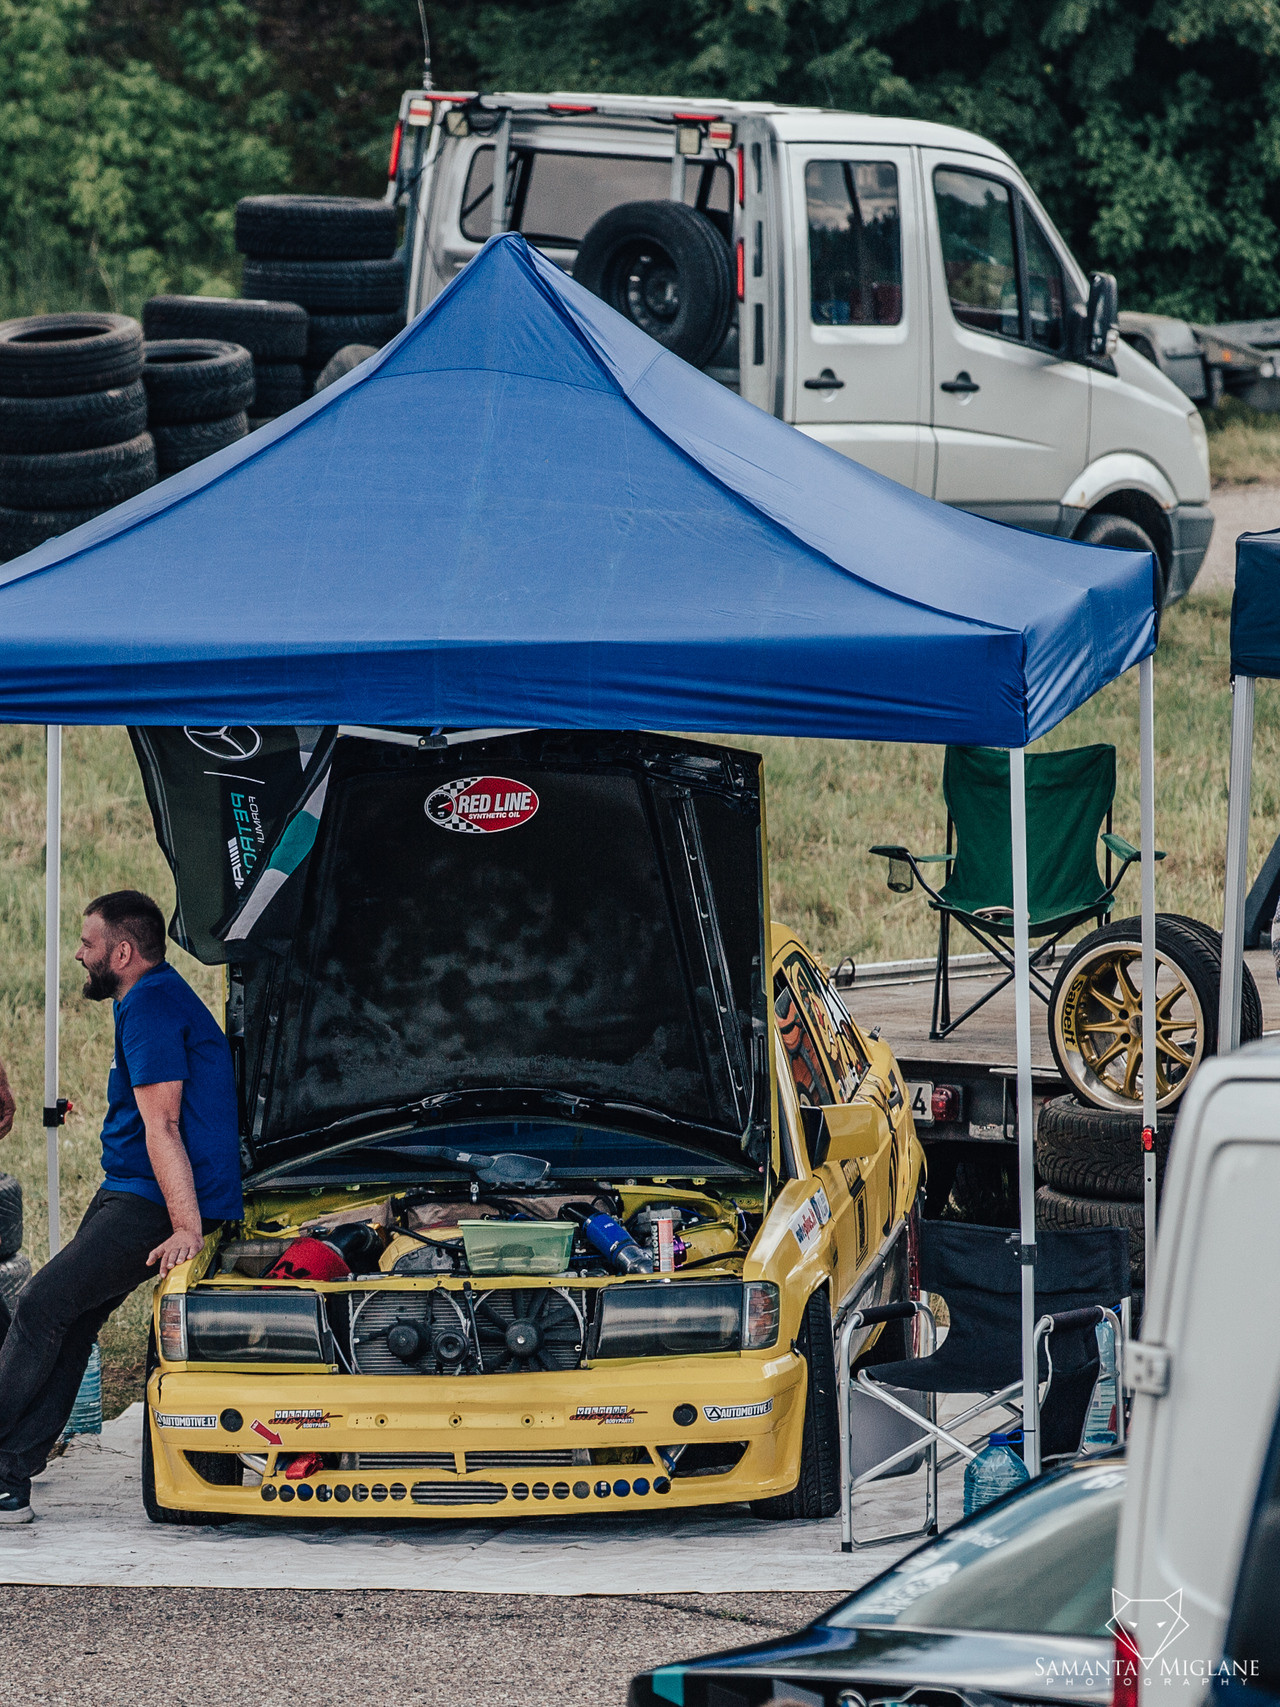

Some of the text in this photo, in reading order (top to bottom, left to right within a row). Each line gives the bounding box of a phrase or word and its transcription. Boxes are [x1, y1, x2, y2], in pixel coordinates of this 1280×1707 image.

[457, 794, 491, 814] RED
[468, 812, 507, 820] SYNTHETIC
[1064, 980, 1083, 1046] Sabelt
[721, 1400, 774, 1418] AUTOMOTIVE.LT
[162, 1416, 216, 1427] AUTOMOTIVE.LT
